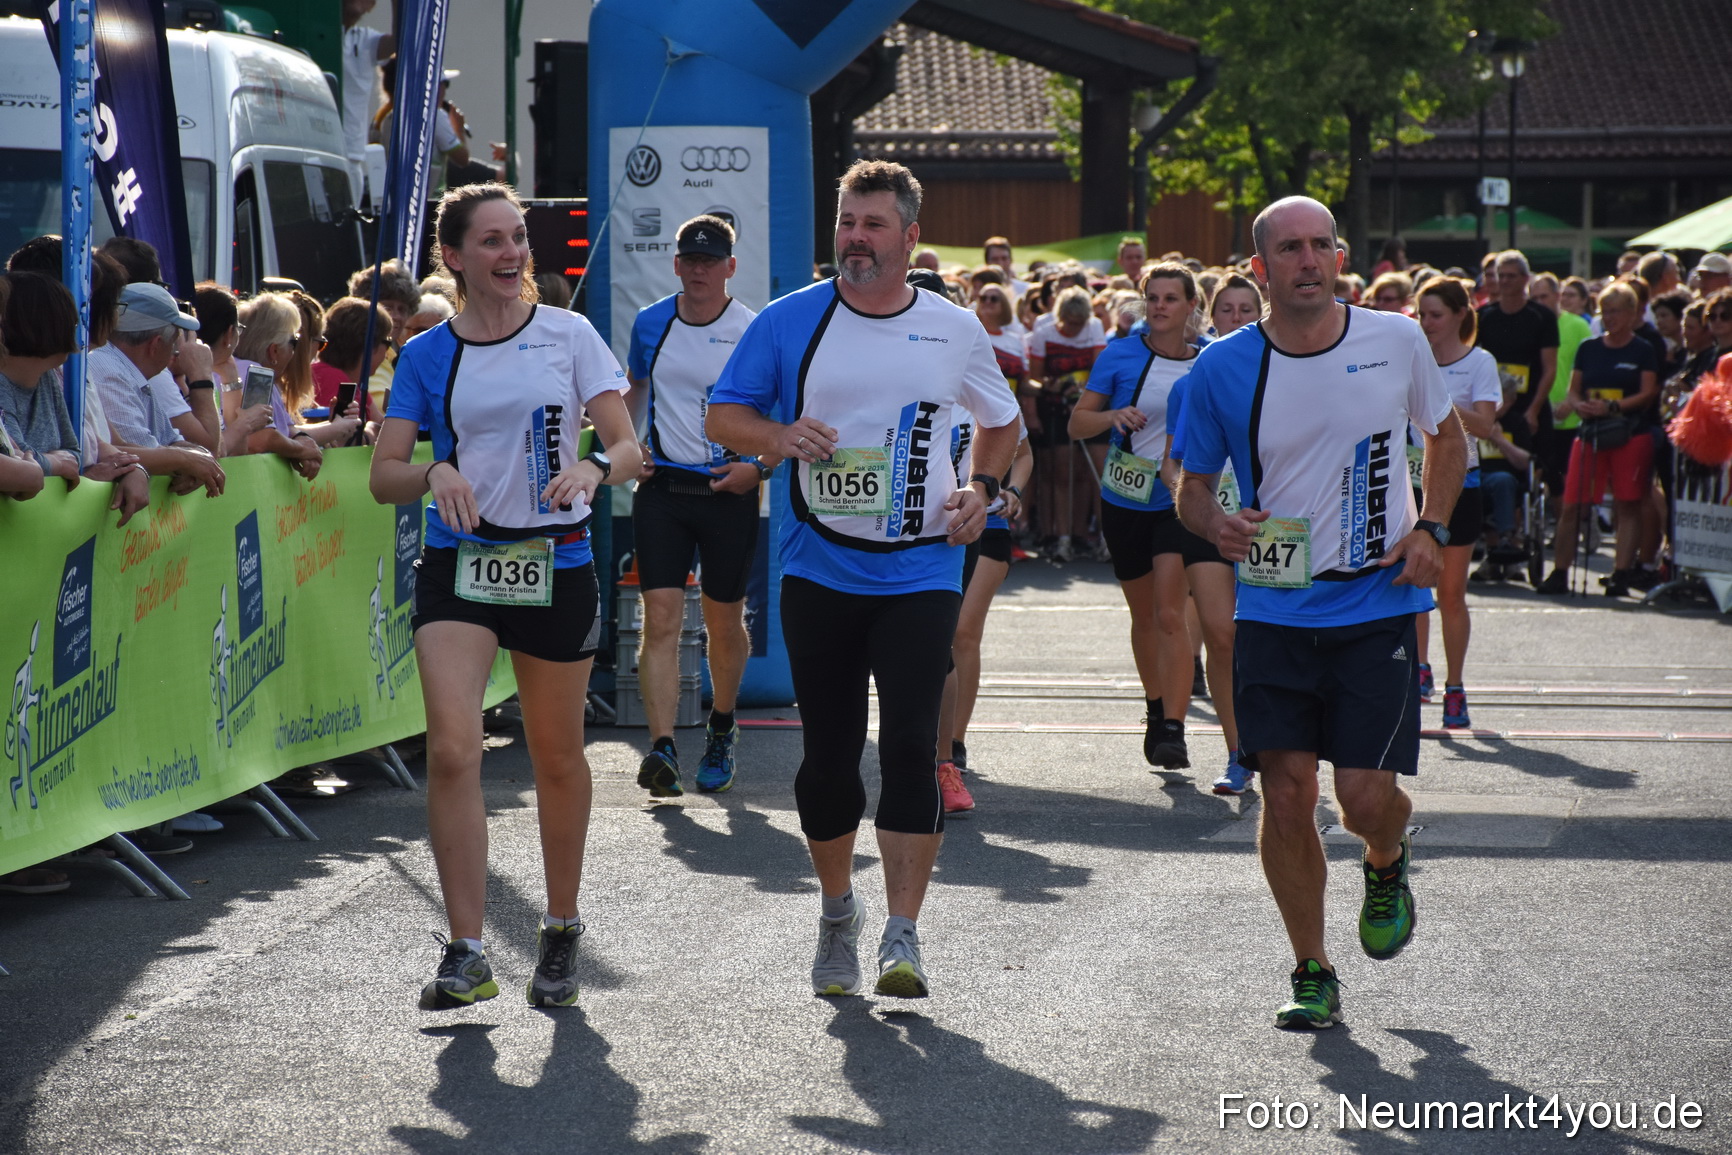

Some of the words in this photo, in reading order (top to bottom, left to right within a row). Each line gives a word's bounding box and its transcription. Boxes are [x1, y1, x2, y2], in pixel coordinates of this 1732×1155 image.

[683, 178, 713, 188] Audi
[623, 243, 672, 252] SEAT
[526, 455, 535, 481] WATER
[889, 429, 908, 532] TECHNOLOGY
[900, 401, 940, 537] HUBER
[1109, 461, 1146, 489] 1060
[1341, 467, 1351, 497] WASTE
[527, 483, 536, 512] Solutions
[815, 471, 879, 497] 1056
[1365, 430, 1392, 561] HUBER
[819, 496, 841, 504] Schmid
[1340, 499, 1349, 529] WATER
[1351, 463, 1366, 563] TECHNOLOGY
[400, 529, 419, 554] Fischer
[1245, 542, 1298, 568] 047
[1338, 532, 1348, 566] Solutions
[241, 552, 258, 579] Fischer
[470, 557, 540, 586] 1036
[1249, 566, 1265, 575] Kölbl
[62, 583, 87, 614] Fischer
[470, 583, 507, 593] Bergmann
[230, 595, 287, 706] firmenlauf
[37, 633, 122, 762] firmenlauf
[39, 747, 76, 797] neumarkt
